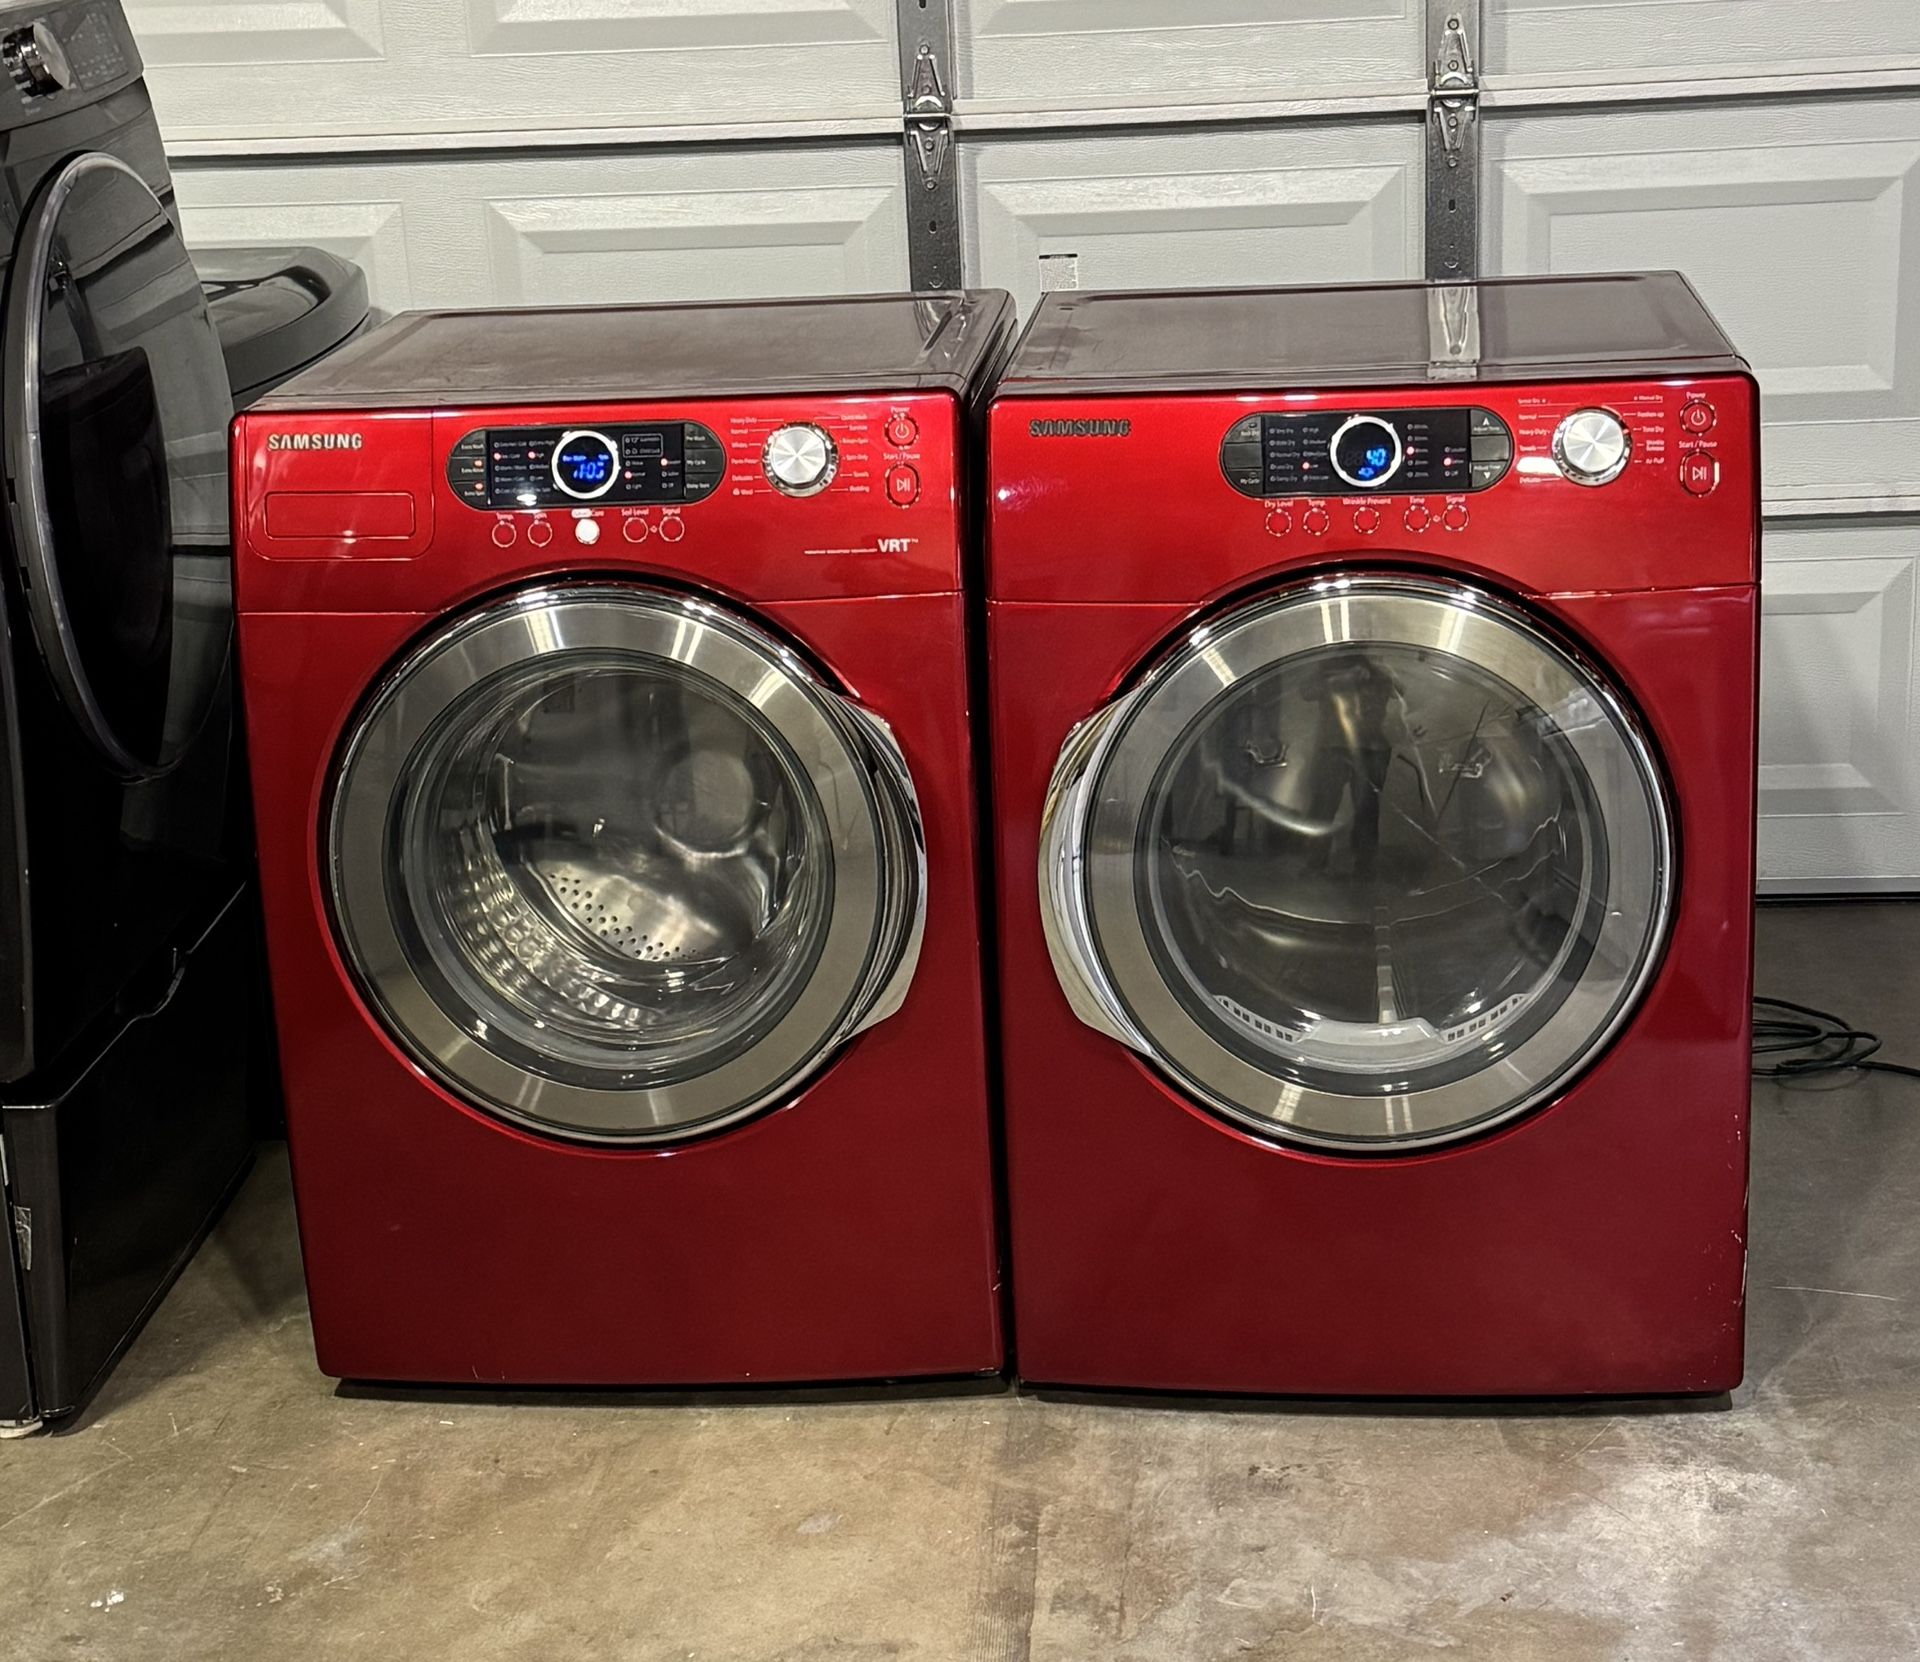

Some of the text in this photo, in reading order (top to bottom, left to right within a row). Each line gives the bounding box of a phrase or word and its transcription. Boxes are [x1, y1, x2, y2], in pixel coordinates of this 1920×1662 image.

[1686, 391, 1706, 399] Power
[1030, 419, 1130, 436] SAMSUNG
[268, 432, 363, 450] SAMSUNG
[1699, 440, 1717, 448] Pause
[902, 452, 920, 460] Pause
[1366, 448, 1386, 467] 40
[1265, 499, 1294, 508] Dry Level
[621, 507, 649, 516] Soil Level
